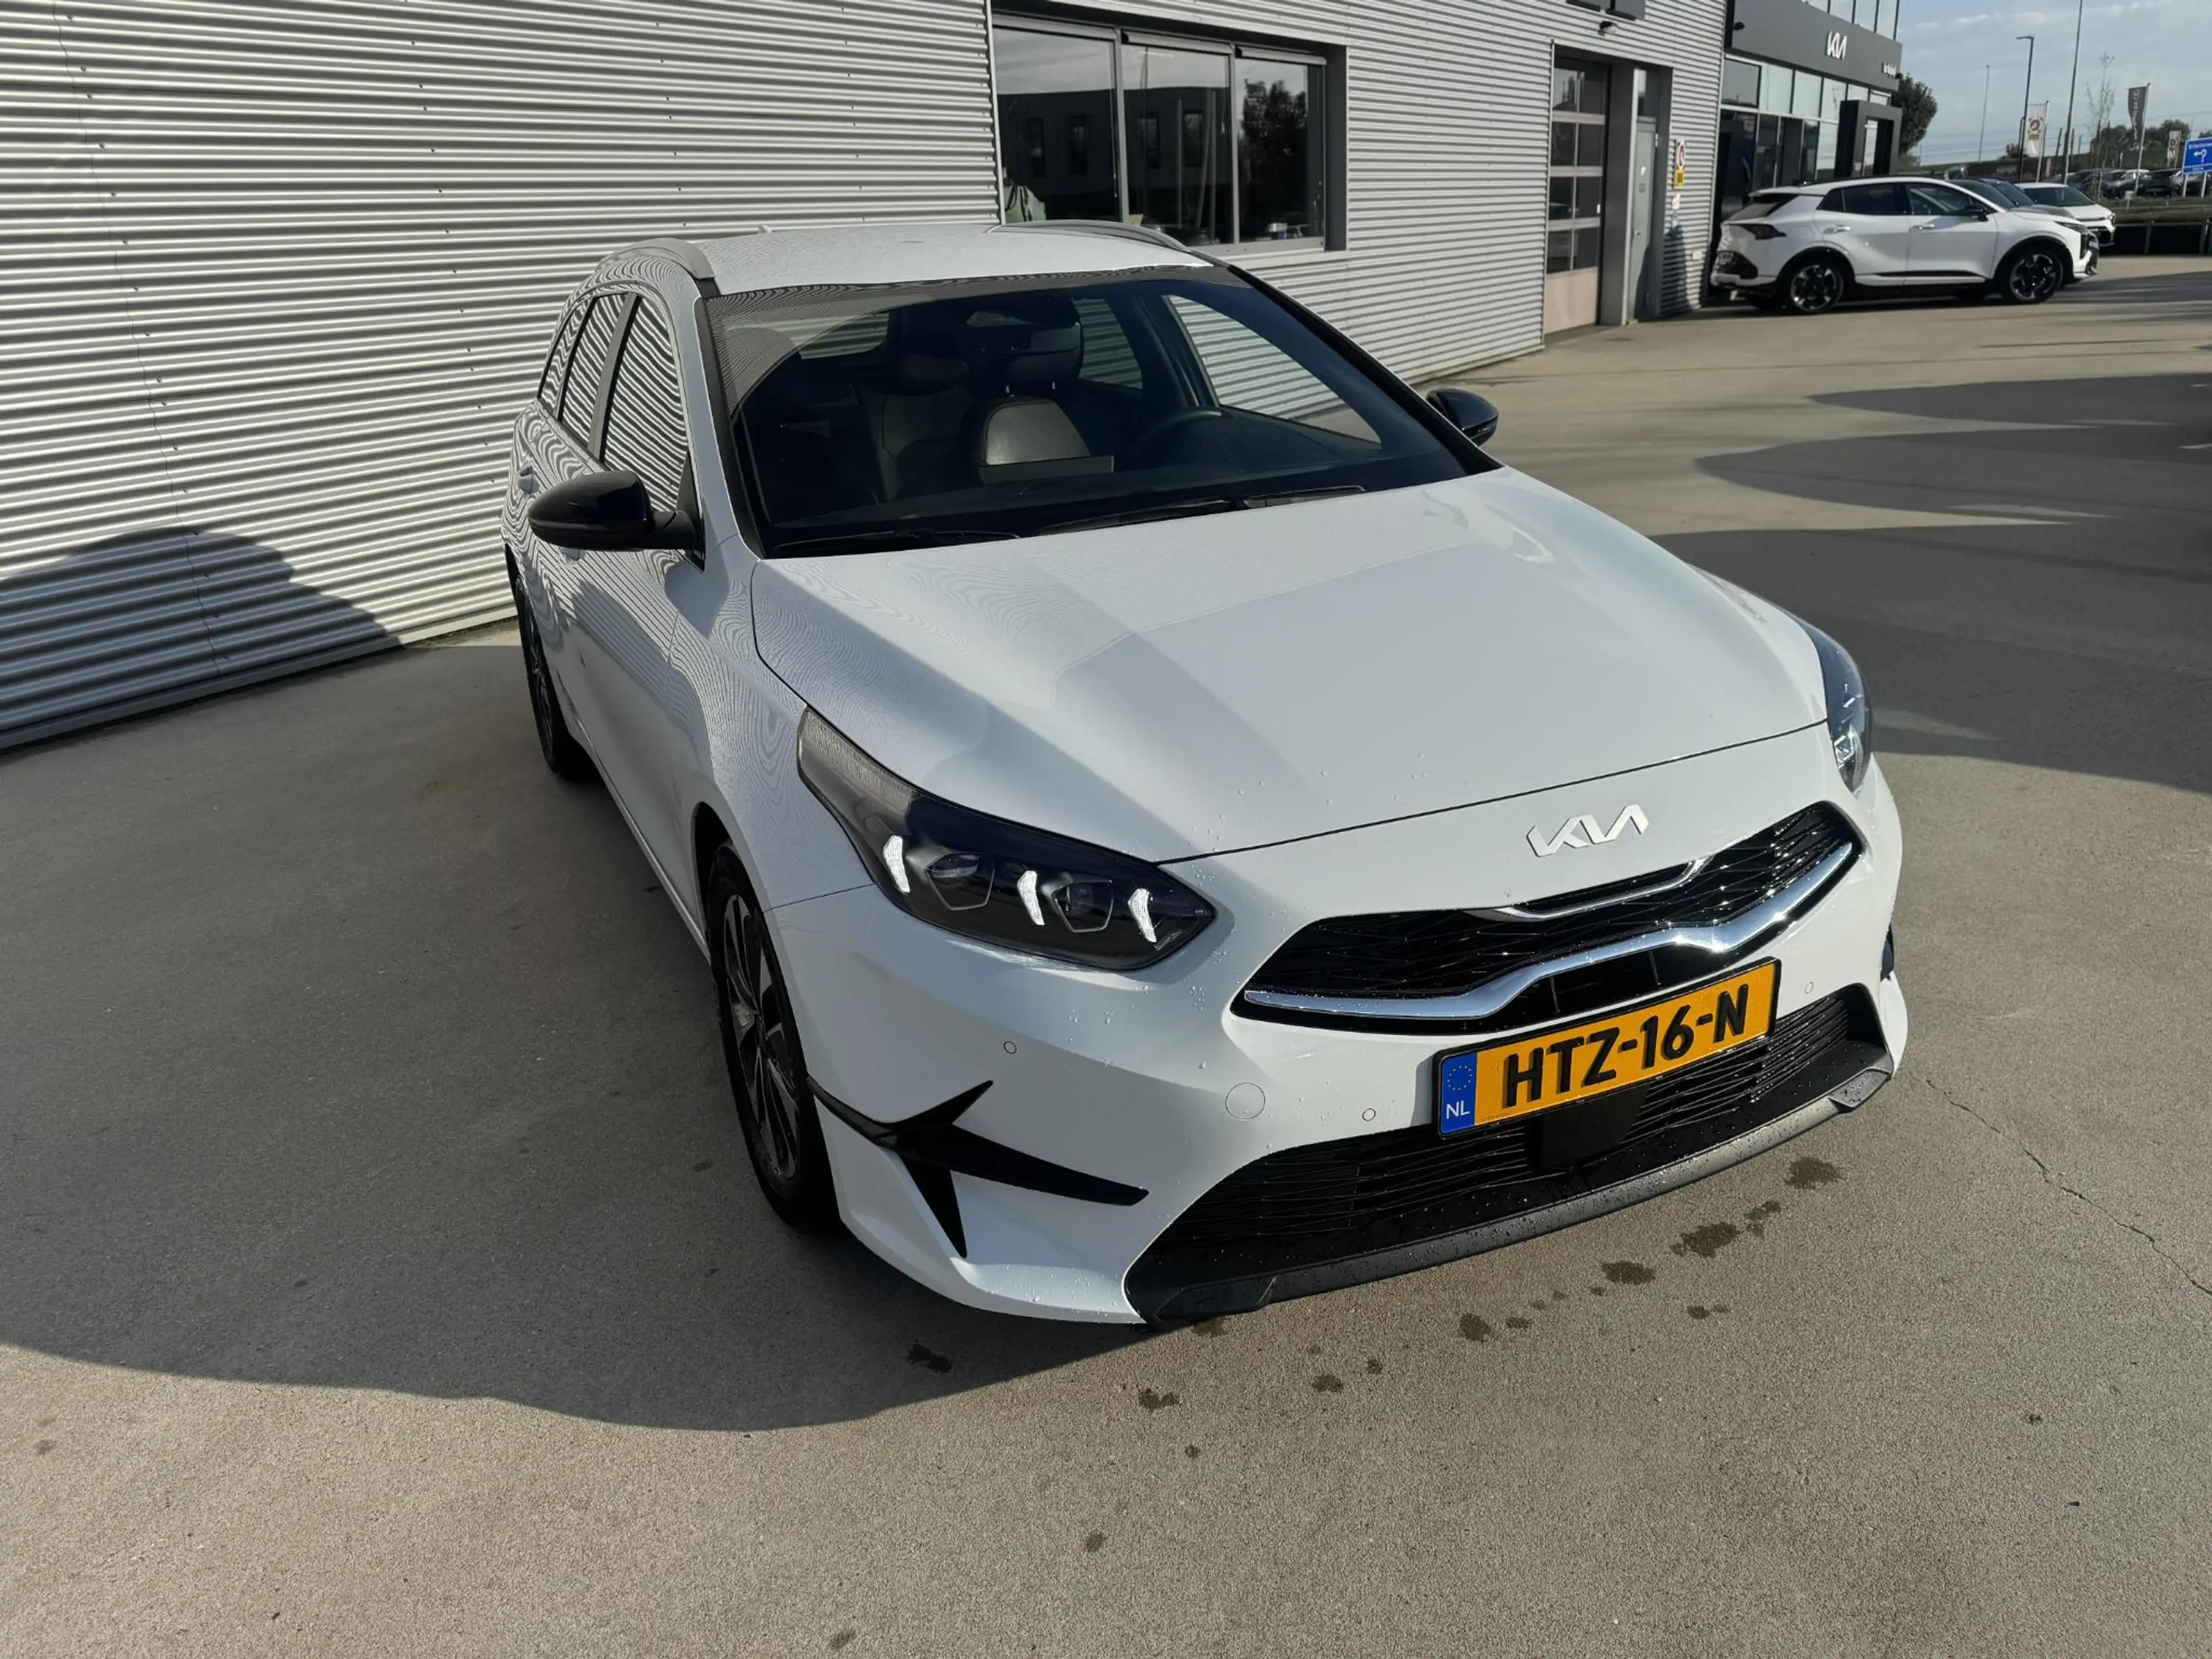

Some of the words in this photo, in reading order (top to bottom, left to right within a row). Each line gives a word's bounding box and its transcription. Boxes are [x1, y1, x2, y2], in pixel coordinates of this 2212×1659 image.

[1526, 804, 1649, 857] KIA
[1502, 983, 1749, 1109] HTZ-16-N
[1446, 1100, 1470, 1119] NL
